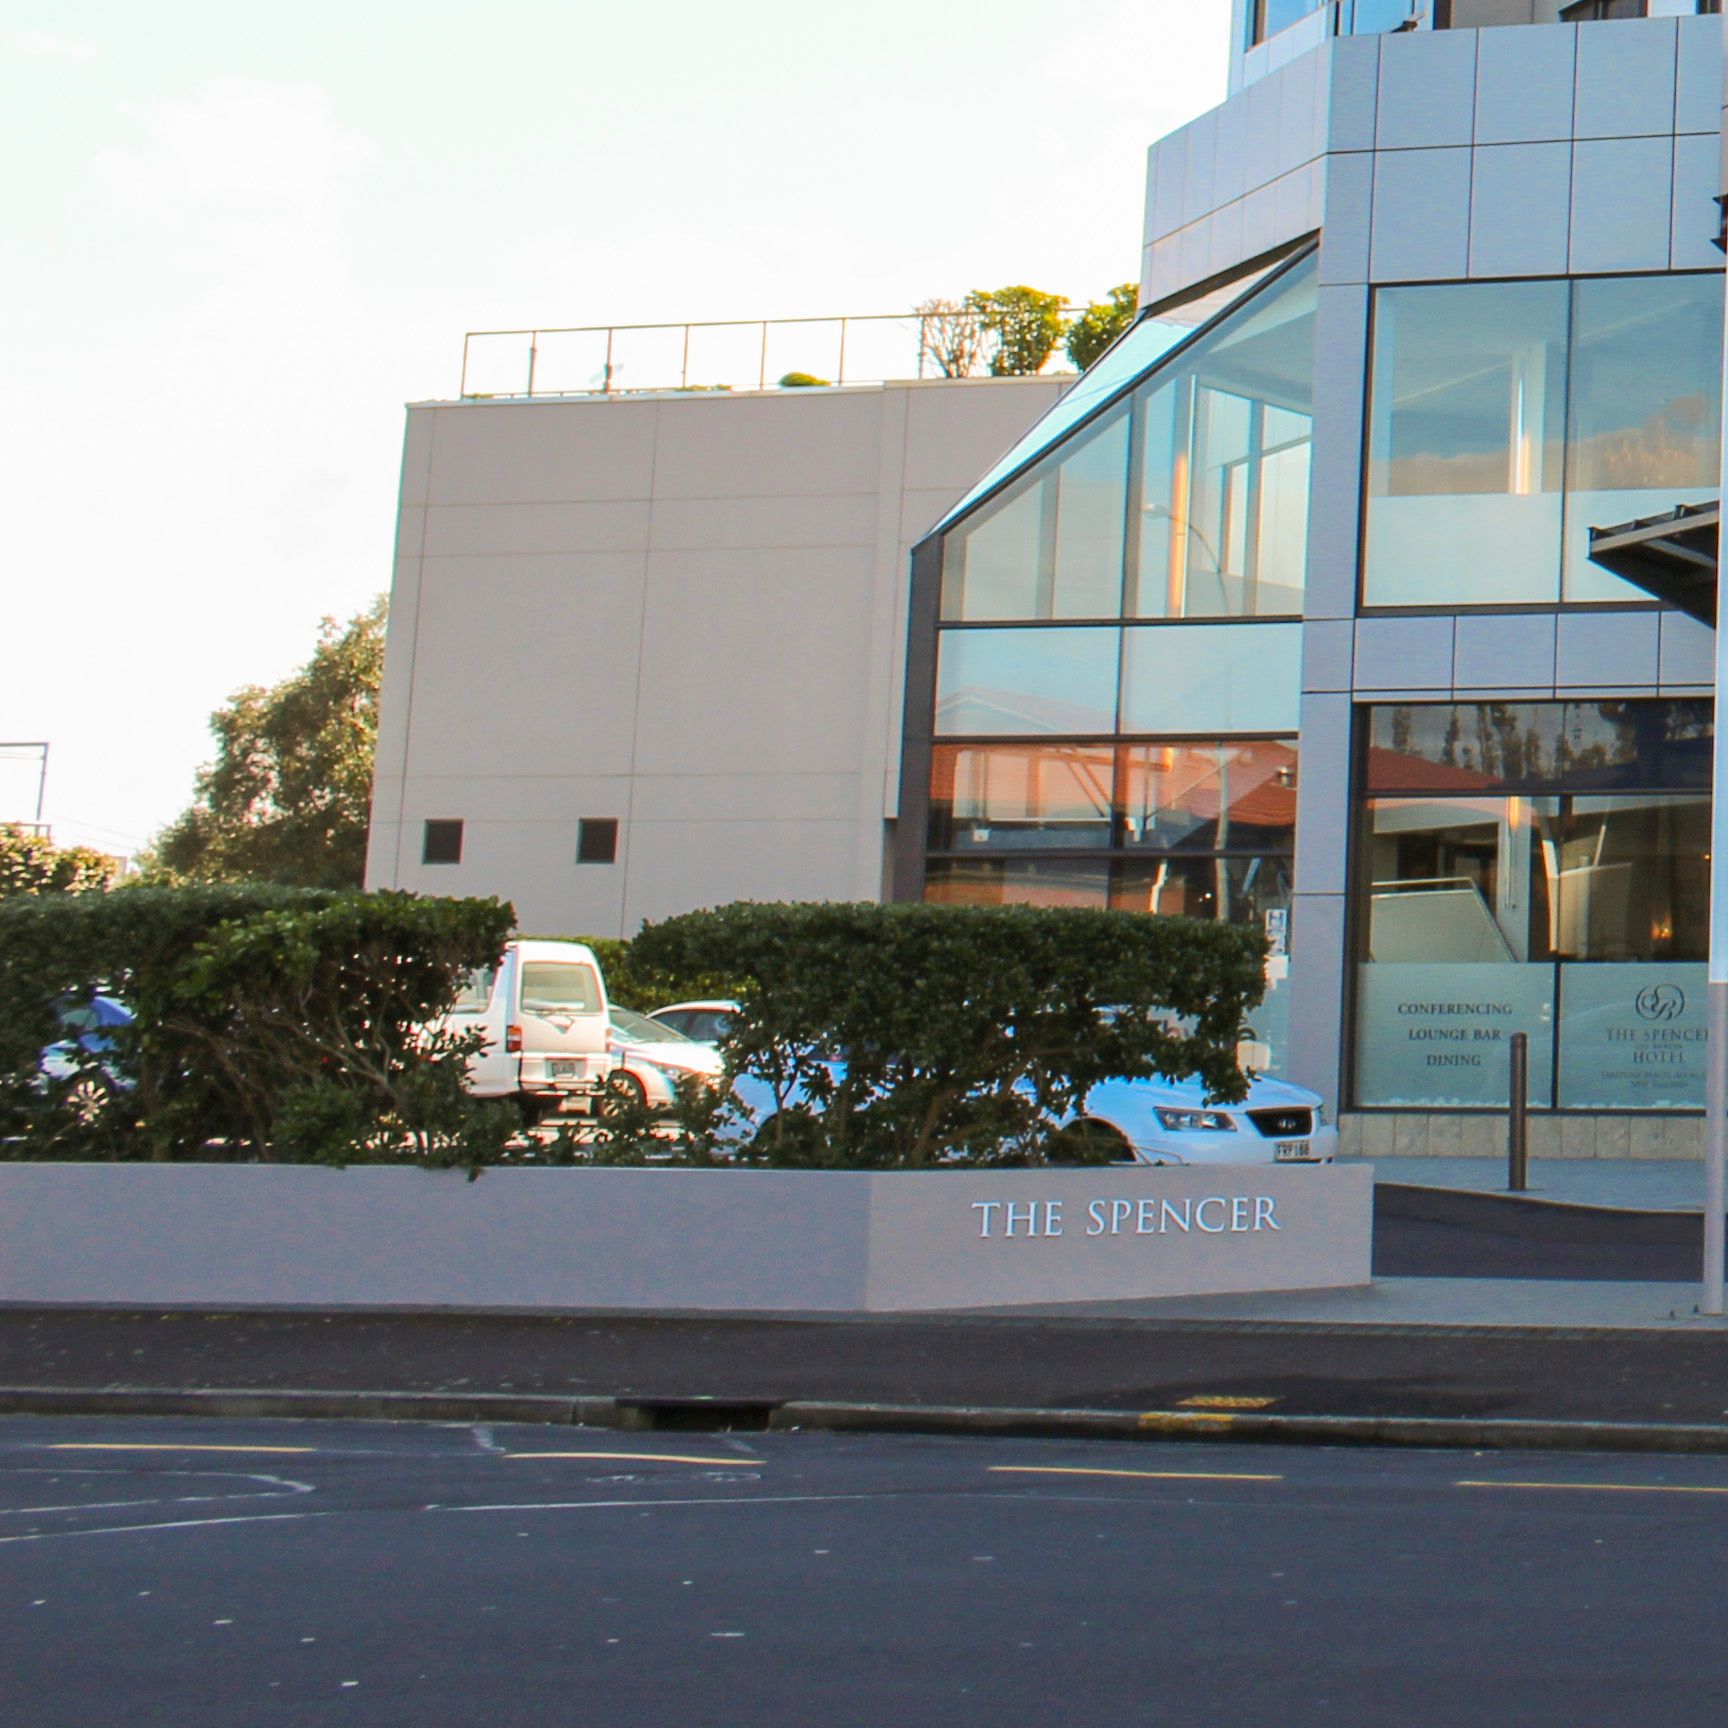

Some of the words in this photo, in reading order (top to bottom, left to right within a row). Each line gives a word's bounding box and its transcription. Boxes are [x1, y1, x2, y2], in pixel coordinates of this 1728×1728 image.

[1398, 1003, 1512, 1014] CONFERENCING
[1408, 1029, 1468, 1040] LOUNGE
[1473, 1029, 1502, 1040] BAR
[1606, 1028, 1636, 1041] THE
[1426, 1055, 1481, 1066] DINING
[1633, 1050, 1684, 1063] HOTEL
[971, 1200, 1063, 1238] THE
[1085, 1196, 1282, 1236] SPENCER
